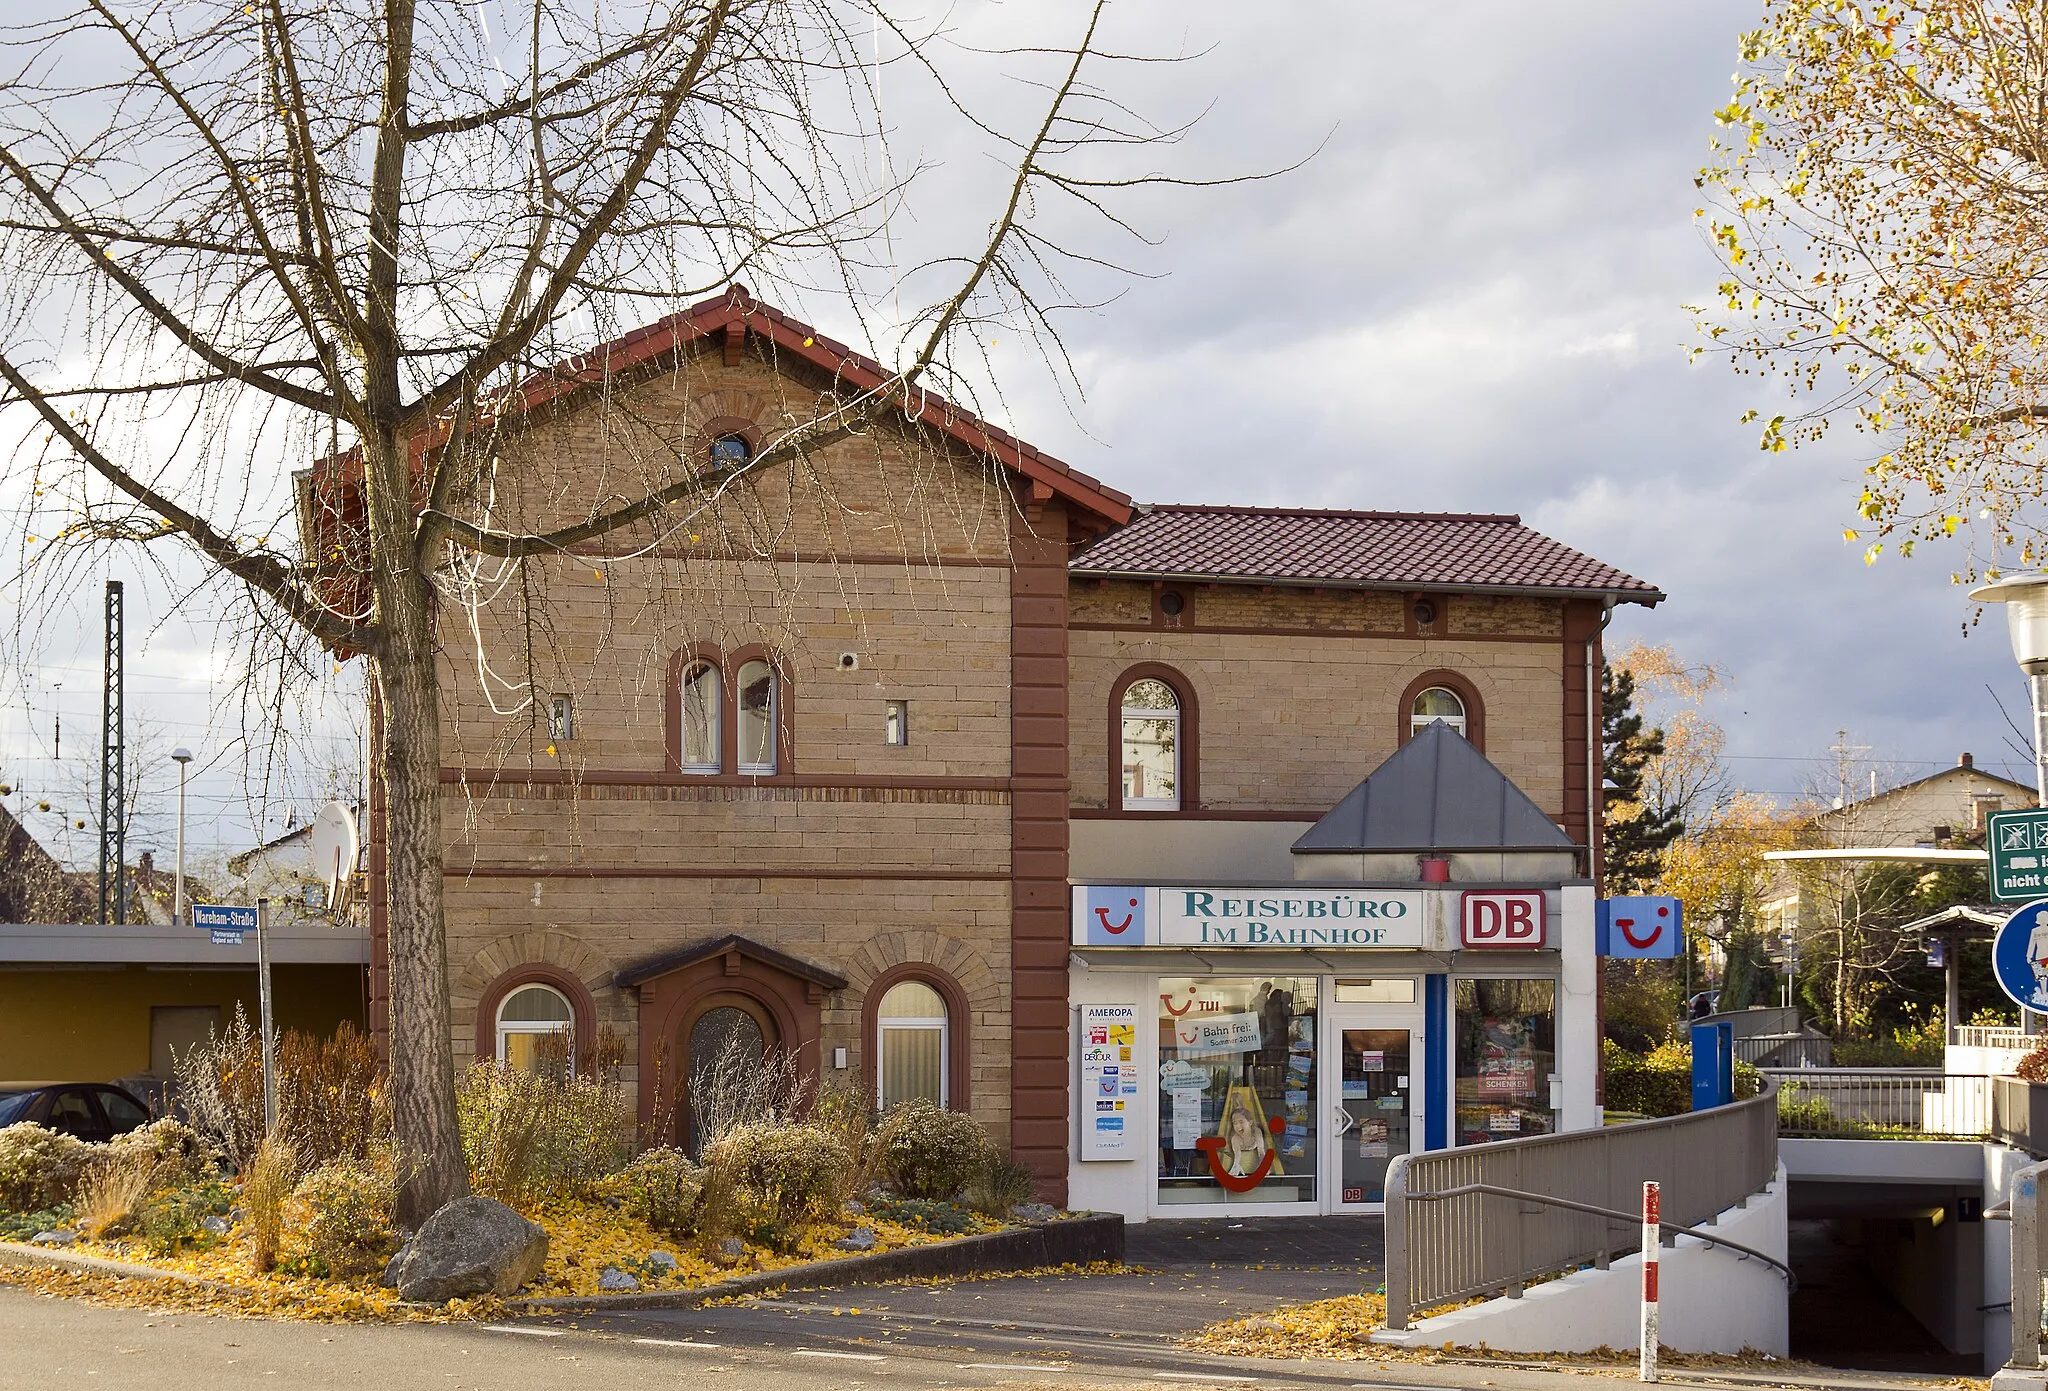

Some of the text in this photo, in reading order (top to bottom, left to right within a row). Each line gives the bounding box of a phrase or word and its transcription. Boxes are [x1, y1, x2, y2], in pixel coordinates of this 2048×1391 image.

[2003, 874, 2041, 889] nicht
[1181, 891, 1407, 919] REISEBÜRO
[195, 909, 254, 926] Wareham-Straße
[1472, 899, 1534, 939] DB
[1199, 921, 1387, 944] IM BAHNHOF
[1088, 1008, 1133, 1017] AMEROPA
[1198, 1000, 1219, 1012] TUI
[1203, 1022, 1251, 1037] Bahn frei:
[1209, 1034, 1257, 1047] Sommer 2011!
[1485, 1080, 1528, 1088] SCHENKEN
[1345, 1189, 1360, 1200] DB
[1961, 1198, 1969, 1215] 1
